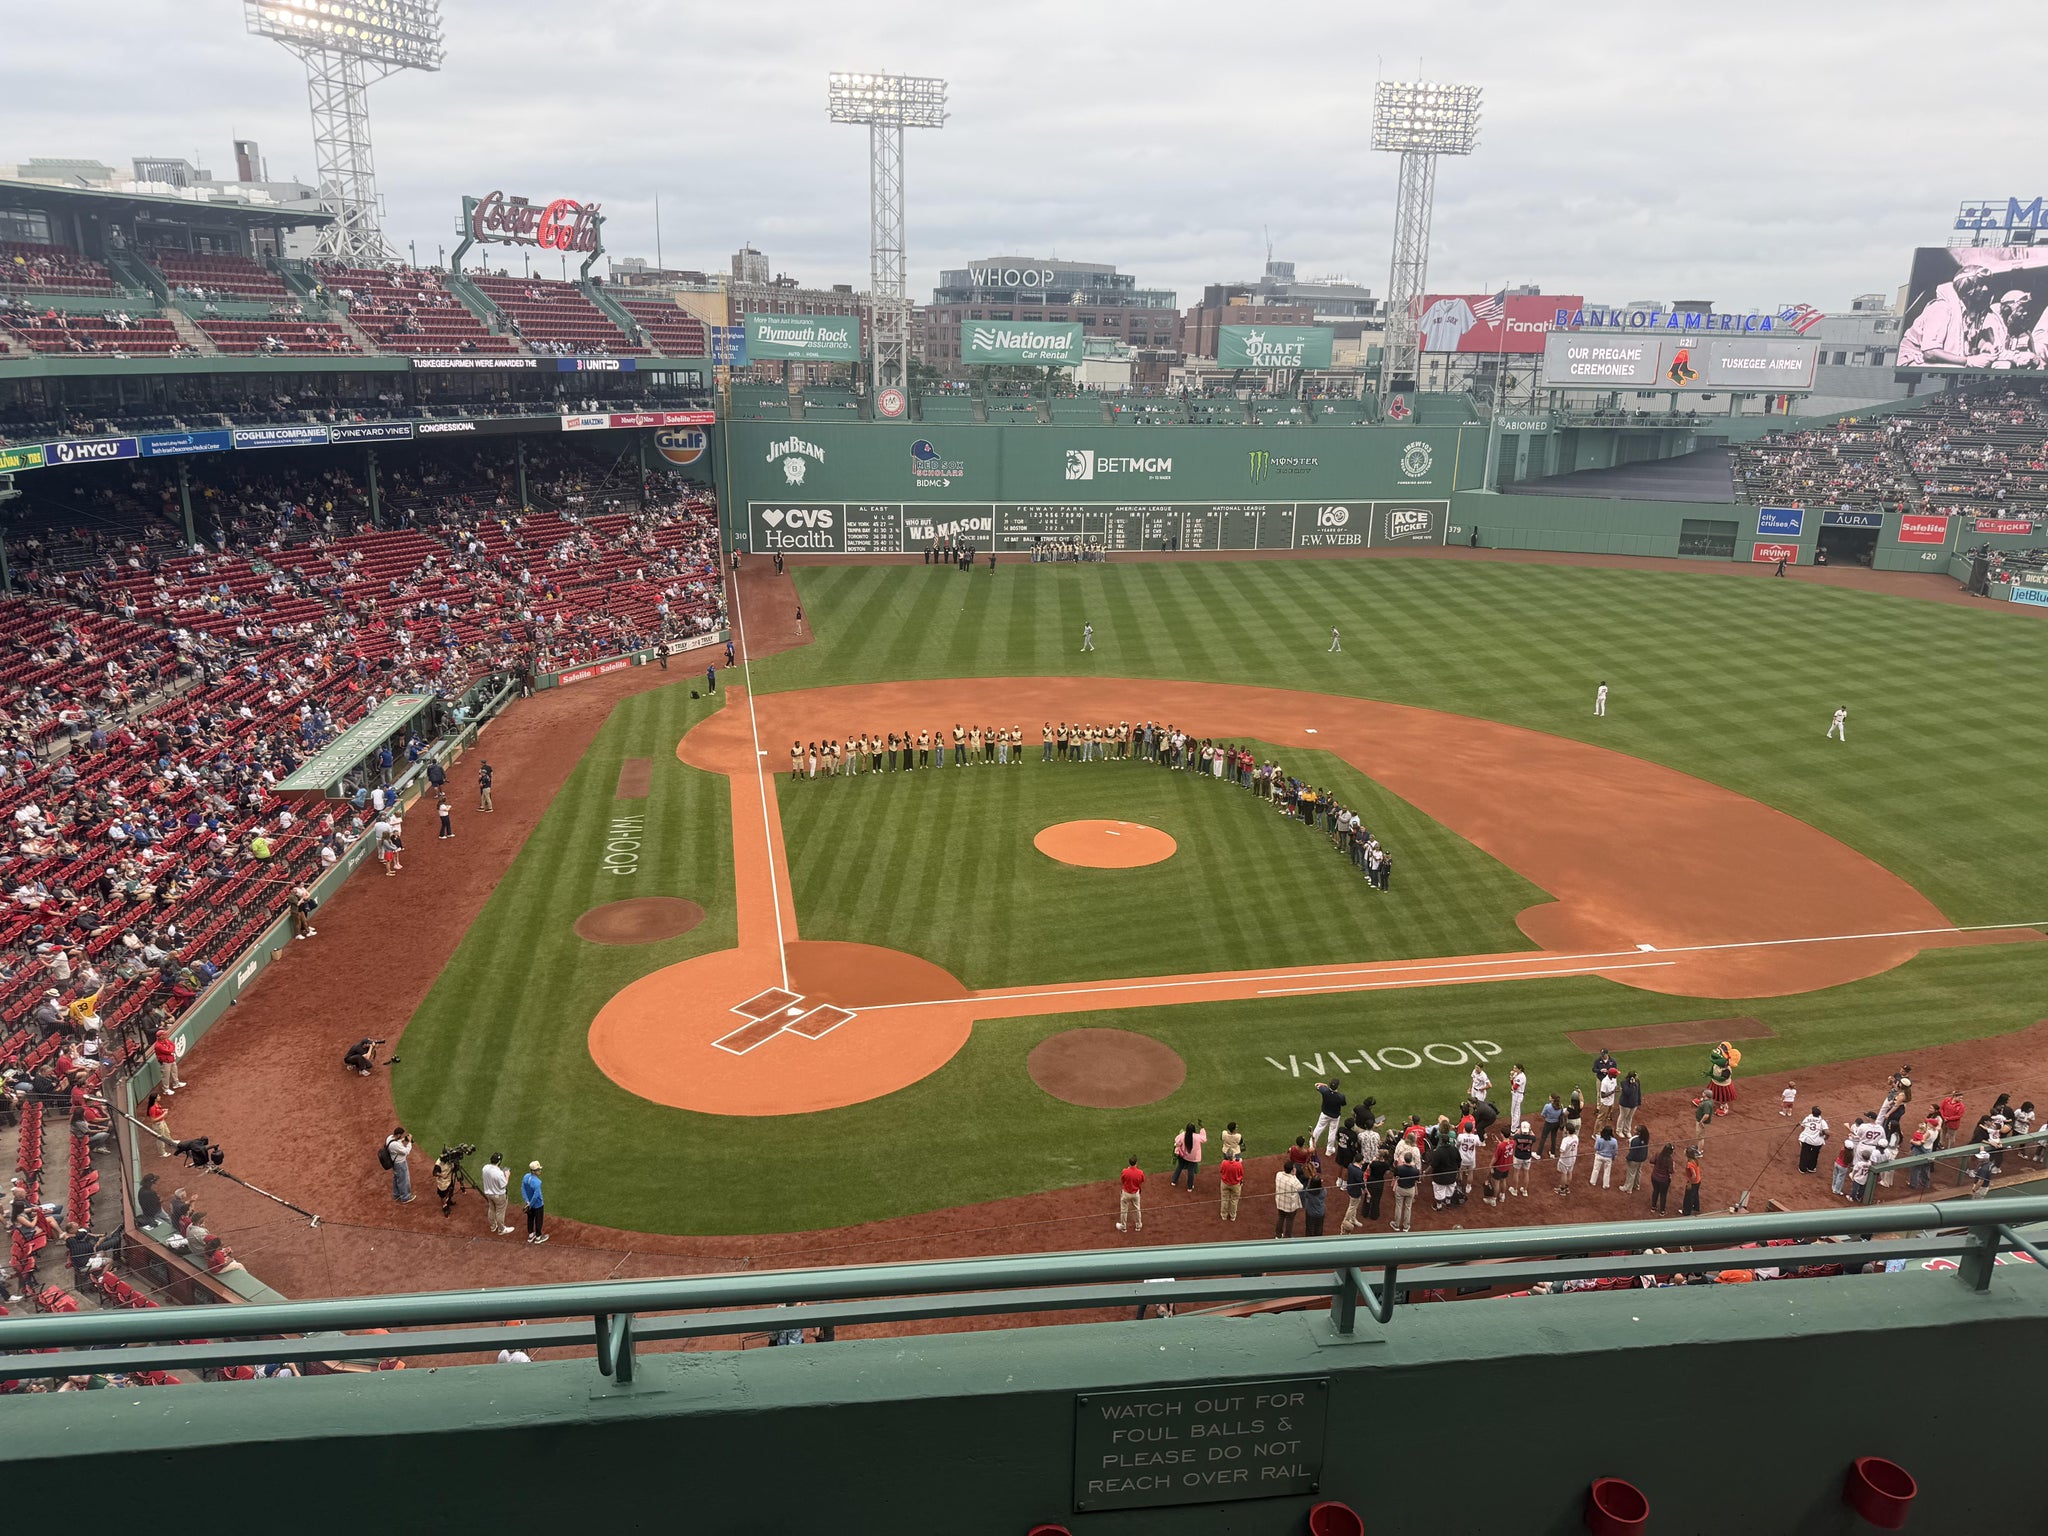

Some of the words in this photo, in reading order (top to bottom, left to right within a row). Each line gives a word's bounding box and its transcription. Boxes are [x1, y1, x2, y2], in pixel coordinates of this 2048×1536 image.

[2005, 196, 2048, 229] M
[970, 268, 1054, 287] WHOOP
[1555, 309, 1620, 328] BANK
[1631, 311, 1660, 328] OF
[1666, 312, 1773, 332] AMERICA
[758, 326, 814, 341] Plymouth
[817, 328, 848, 341] Rock
[1679, 338, 1692, 346] 1:21
[1246, 342, 1304, 356] DRAFT
[1568, 348, 1588, 359] OUR
[1592, 349, 1642, 360] PREGAME
[475, 360, 493, 368] WERE
[586, 360, 619, 370] UNITED
[1252, 354, 1301, 366] KINGS
[1722, 358, 1766, 369] TUSKEGEE
[1769, 360, 1802, 370] AIRMEN
[1571, 364, 1634, 375] CEREMONIES
[341, 428, 384, 437] VINEYARD
[385, 427, 410, 435] VINES
[419, 422, 475, 433] CONGRESSIONAL
[1505, 422, 1548, 430] ABIOMED
[236, 432, 275, 440] COGHLIN
[276, 429, 326, 438] COMPANIES
[657, 432, 702, 448] Gulf
[77, 444, 117, 457] HYCU
[766, 441, 789, 463] JIM
[790, 436, 825, 464] BEAM
[917, 462, 938, 470] RED
[942, 462, 964, 470] SOX
[1098, 458, 1172, 472] BETMGM
[786, 509, 833, 528] CVS
[1395, 512, 1428, 524] ACE
[1762, 514, 1776, 523] city
[937, 518, 992, 538] MASON
[1395, 523, 1428, 533] TICKET
[1902, 523, 1944, 532] Safelite
[1998, 523, 2031, 532] TICKET
[766, 530, 834, 548] Health
[1301, 534, 1322, 546] F.W.
[1326, 534, 1362, 544] WEBB
[1760, 548, 1790, 558] IRVING
[1921, 552, 1936, 560] 420
[2014, 589, 2048, 602] jetBlu
[600, 661, 626, 673] Safelite
[563, 671, 592, 684] Safelite
[602, 814, 644, 875] WHOOP
[1264, 1040, 1502, 1078] WHOOP
[1810, 1123, 1817, 1132] 3
[1866, 1131, 1880, 1140] 67
[1462, 1144, 1474, 1152] 34
[1101, 1402, 1182, 1420] WATCH
[1194, 1397, 1244, 1414] OUT
[1256, 1392, 1305, 1409] FOR
[1112, 1427, 1178, 1444] FOUL
[1191, 1420, 1264, 1438] BALLS
[1278, 1416, 1293, 1432] &
[1102, 1449, 1196, 1468] PLEASE
[1208, 1445, 1242, 1461] DO
[1254, 1440, 1301, 1457] NOT
[1088, 1475, 1170, 1494] REACH
[1183, 1469, 1248, 1487] OVER
[1261, 1464, 1311, 1480] RAIL
